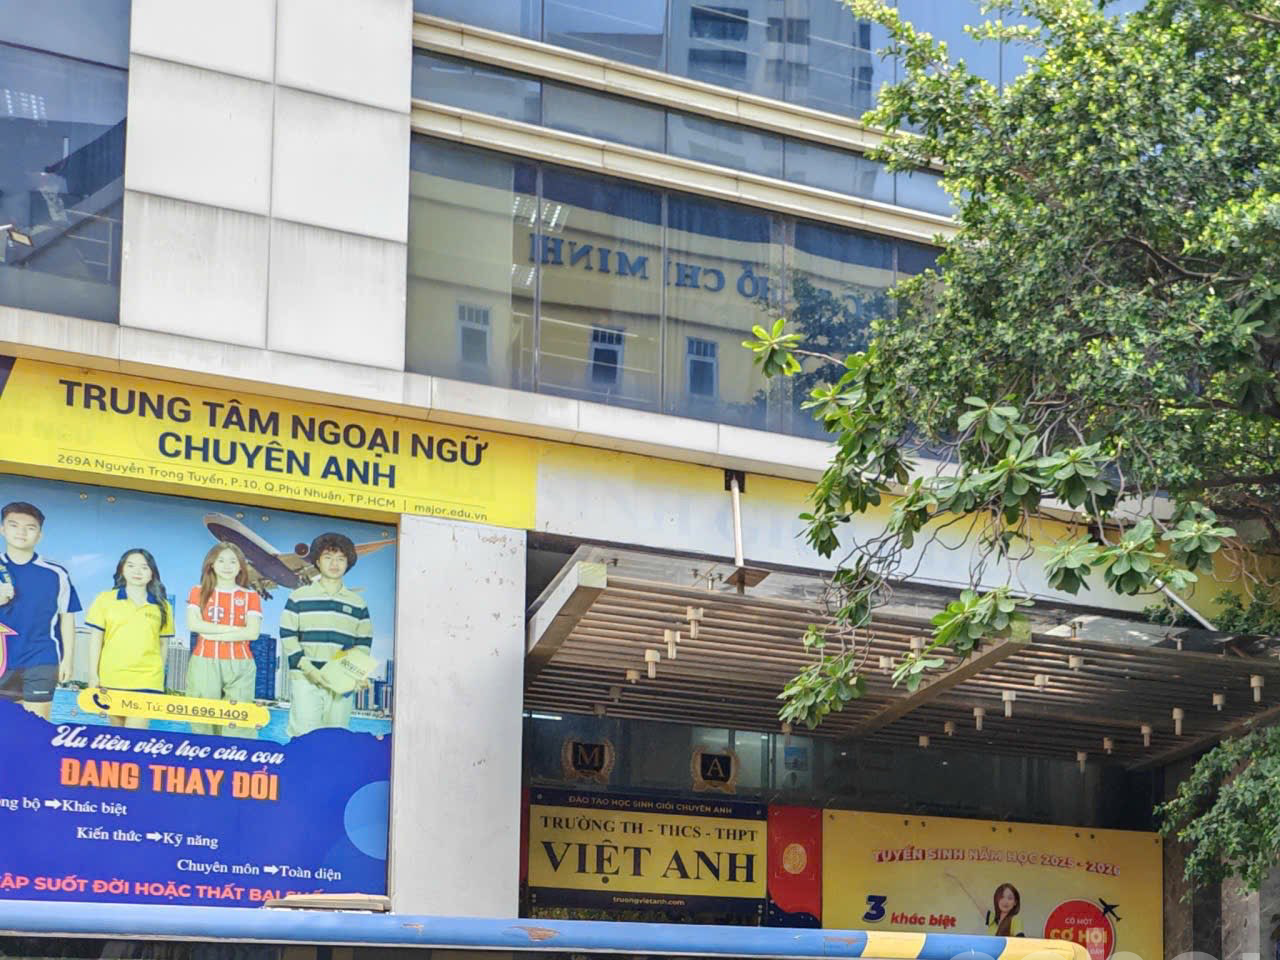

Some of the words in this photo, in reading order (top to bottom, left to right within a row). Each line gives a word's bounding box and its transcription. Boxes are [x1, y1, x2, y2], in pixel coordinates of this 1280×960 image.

[58, 378, 191, 423] TRUNG
[202, 398, 279, 437] TÂM
[291, 415, 399, 458] NGOẠI
[411, 434, 488, 468] NGỮ
[158, 431, 311, 477] CHUYÊN
[320, 454, 396, 489] ANH
[58, 454, 91, 468] 269A
[231, 478, 260, 492] P.10,
[264, 481, 300, 496] Q.Phú
[348, 493, 396, 508] TP.HCM
[414, 503, 488, 522] major.edu.vn
[121, 699, 141, 711] Ms.
[146, 700, 163, 712] Tú:
[166, 703, 189, 715] 091
[192, 706, 215, 718] 696
[219, 708, 248, 721] 1409
[90, 733, 131, 752] tiên
[134, 736, 173, 759] việc
[175, 739, 210, 761] học
[213, 744, 248, 762] của
[251, 750, 284, 765] con
[60, 757, 140, 791] ĐANG
[149, 764, 226, 797] THAY
[232, 766, 279, 801] ĐỔI
[22, 797, 41, 812] bộ
[62, 800, 98, 814] Khác
[101, 801, 128, 816] biệt
[633, 799, 653, 809] SINH
[676, 803, 711, 813] CHUYÊN
[713, 806, 732, 814] ANH
[76, 826, 109, 841] Kiến
[113, 830, 143, 843] thức
[163, 832, 183, 847] Kỹ
[187, 836, 219, 850] năng
[540, 811, 616, 833] TRƯỜNG
[620, 820, 643, 835] TH
[657, 823, 701, 838] THCS
[715, 826, 758, 842] THPT
[176, 859, 228, 877] Chuyên
[232, 863, 260, 876] môn
[279, 865, 312, 878] Toàn
[314, 867, 342, 882] diện
[540, 839, 652, 884] VIỆT
[662, 850, 757, 883] ANH
[926, 848, 965, 861] SINH
[968, 848, 1001, 862] NĂM
[1006, 851, 1037, 866] HỌC
[34, 874, 88, 893] SUỐT
[92, 877, 129, 895] ĐỜI
[135, 881, 191, 899] HOẶC
[195, 882, 245, 900] THẤT
[612, 896, 686, 906] truongvietanh.com
[863, 894, 888, 923] 3
[890, 911, 926, 926] khác
[929, 913, 957, 930] biệt
